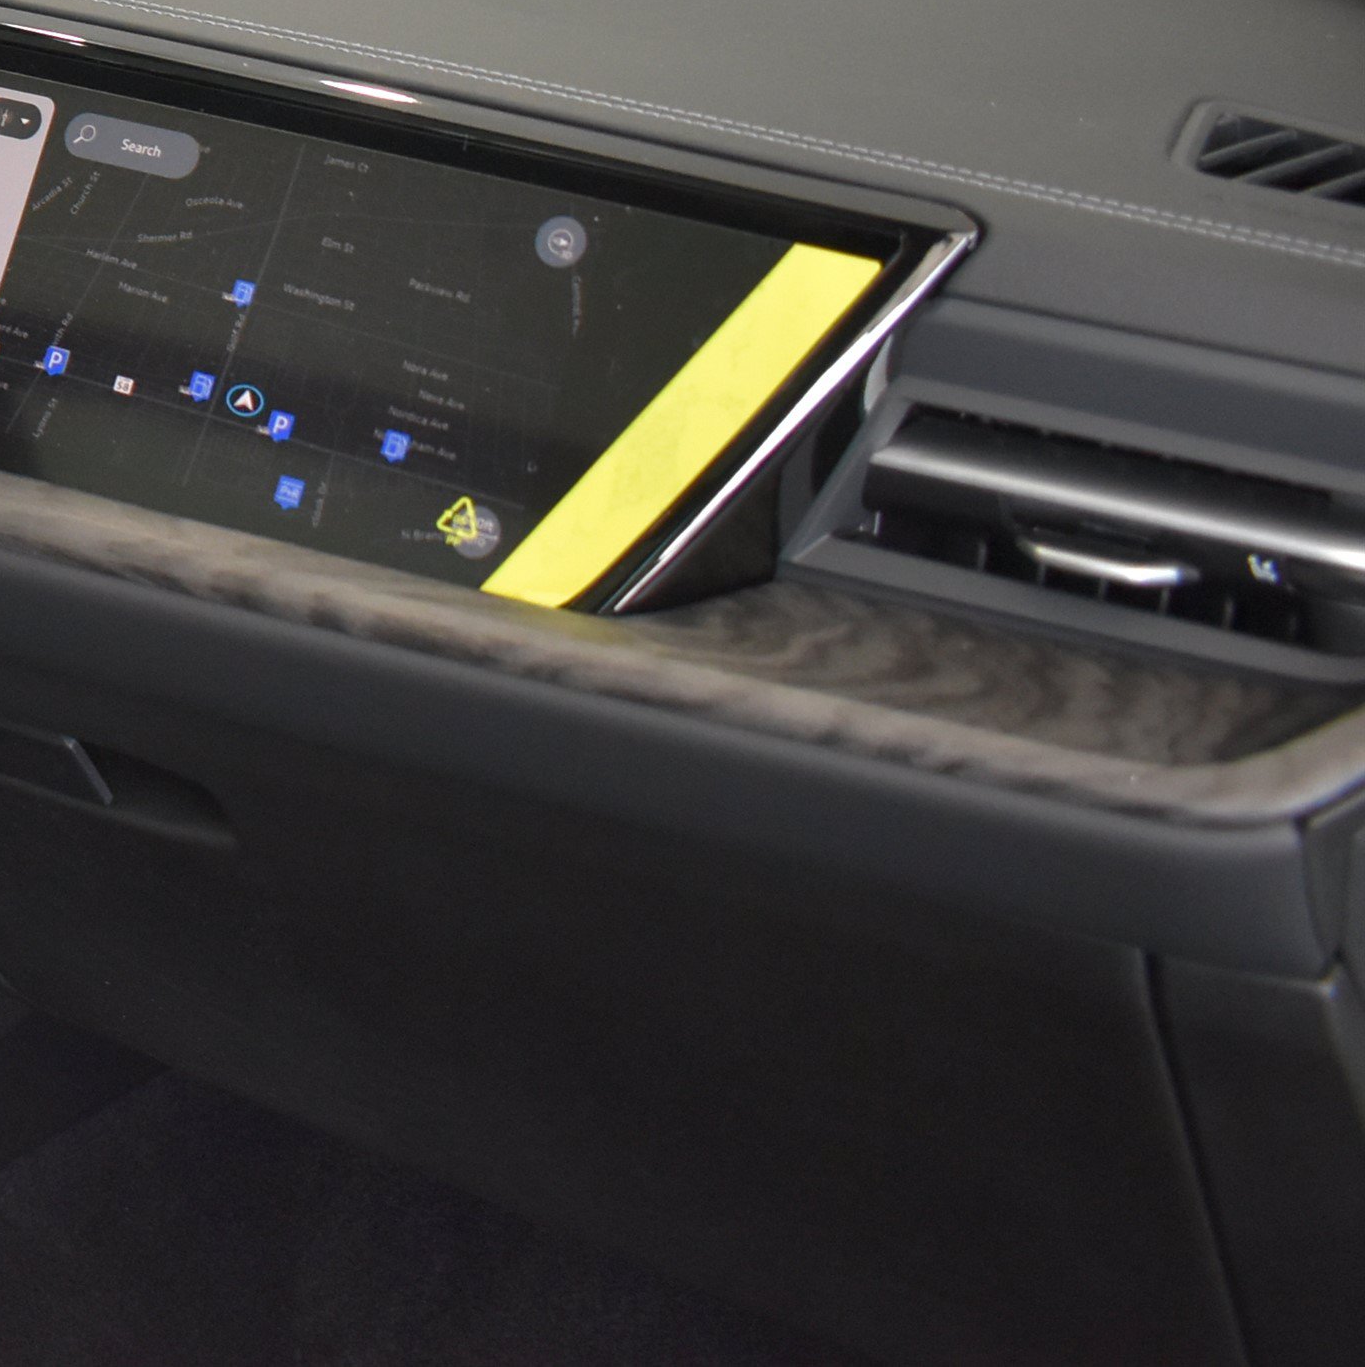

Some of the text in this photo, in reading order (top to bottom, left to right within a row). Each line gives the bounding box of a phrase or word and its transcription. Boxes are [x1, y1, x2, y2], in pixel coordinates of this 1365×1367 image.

[120, 138, 162, 158] Search
[70, 180, 91, 215] Church
[48, 351, 63, 369] P
[115, 381, 130, 393] 58
[272, 416, 288, 433] P
